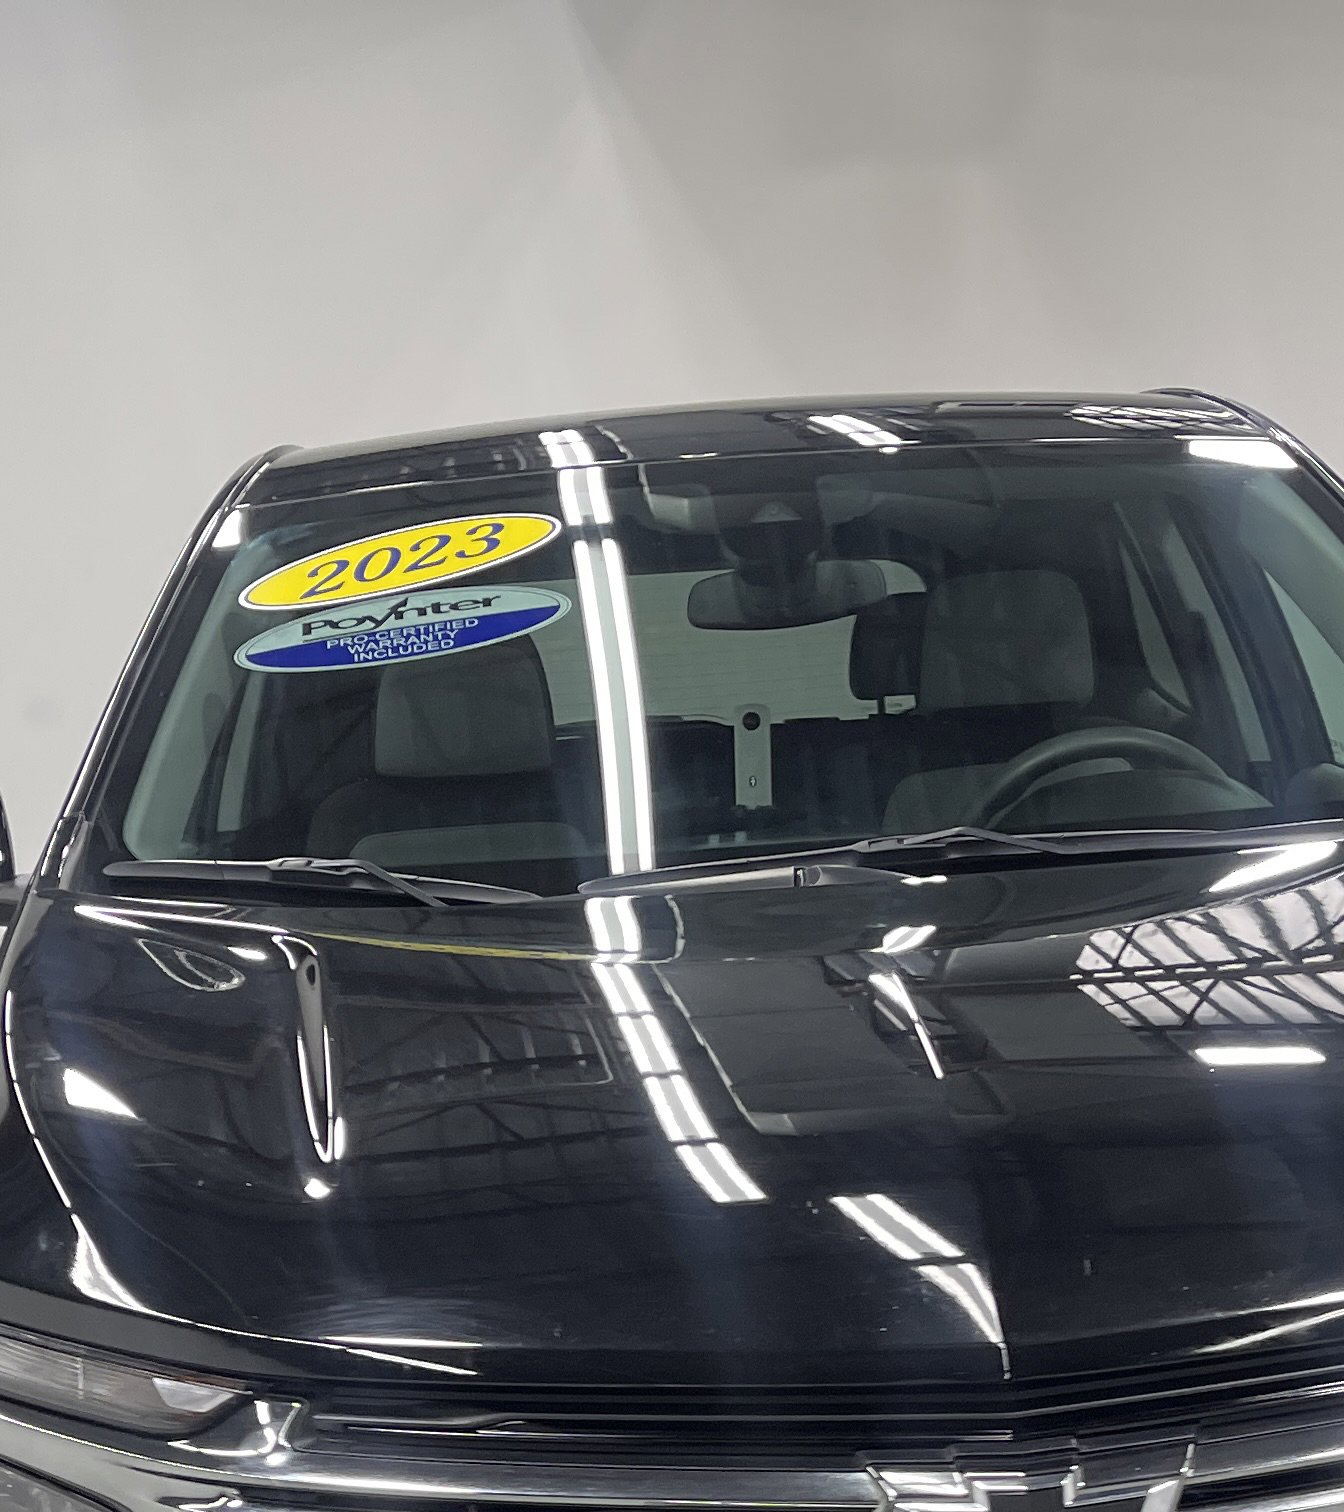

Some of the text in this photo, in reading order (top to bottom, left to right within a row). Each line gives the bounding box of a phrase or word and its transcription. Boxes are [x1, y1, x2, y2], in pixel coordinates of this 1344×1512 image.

[299, 522, 504, 599] 2023
[302, 597, 502, 637] Poynter
[326, 618, 479, 650] PRO-CERTIFIED
[347, 629, 458, 655] WARRANTY
[354, 639, 455, 663] INCLUDED
